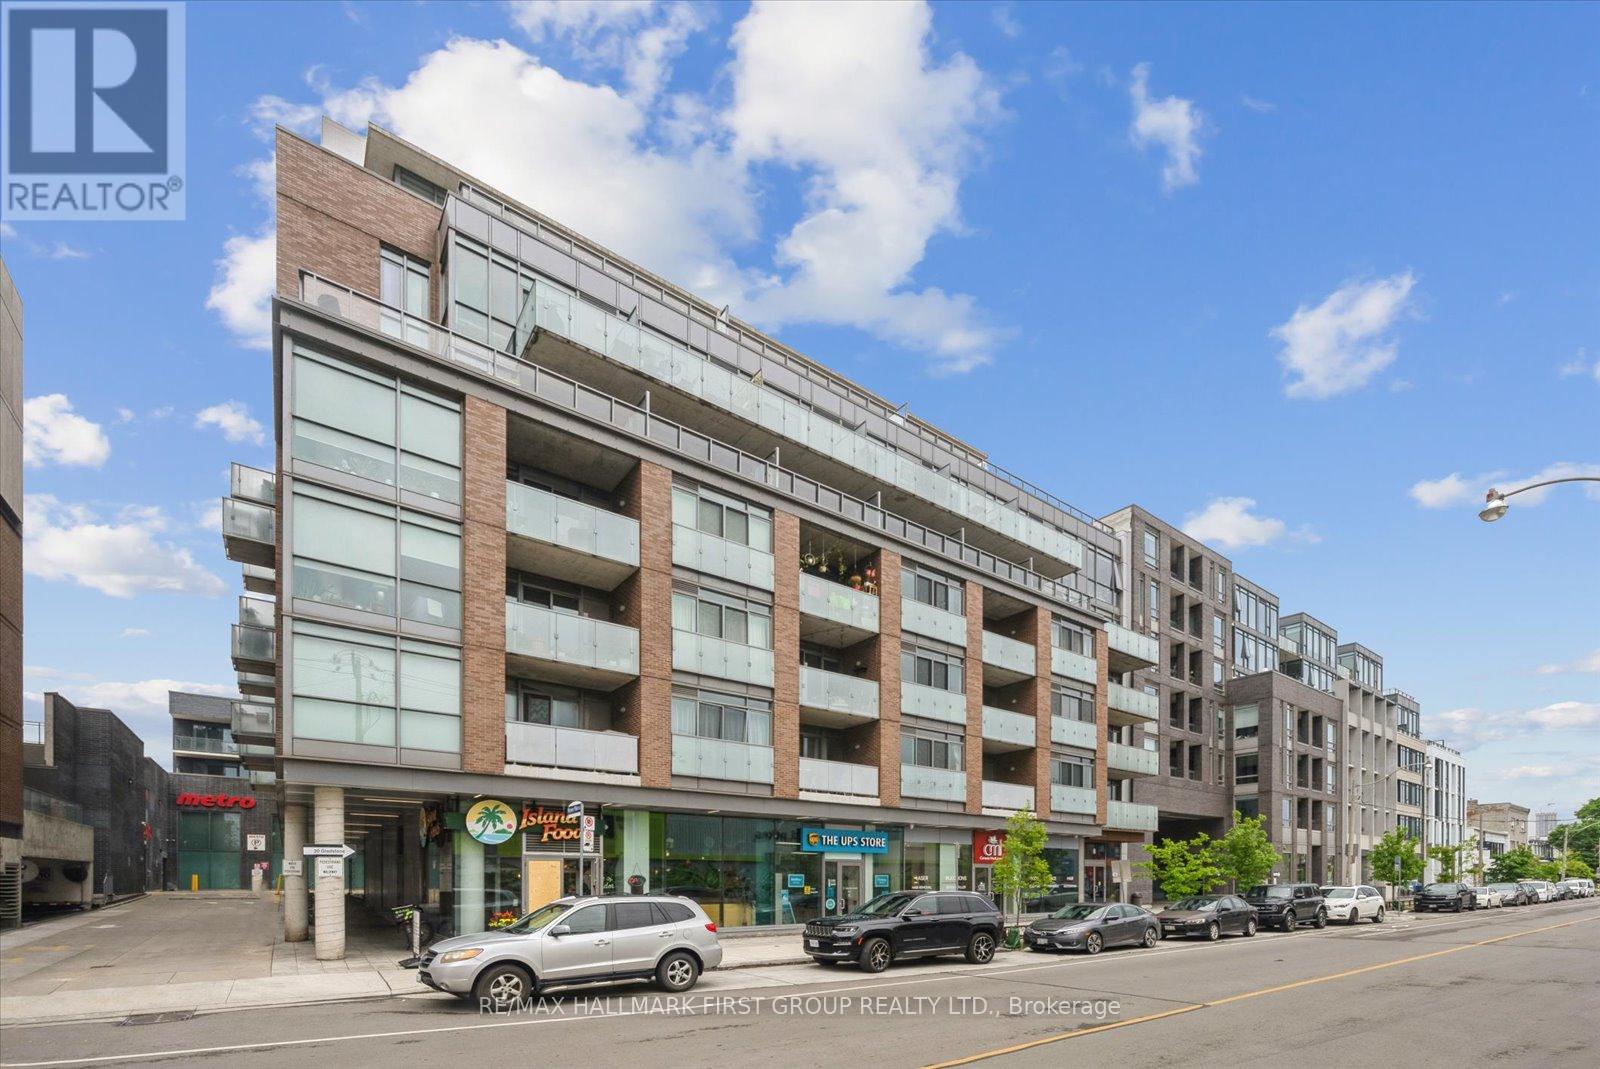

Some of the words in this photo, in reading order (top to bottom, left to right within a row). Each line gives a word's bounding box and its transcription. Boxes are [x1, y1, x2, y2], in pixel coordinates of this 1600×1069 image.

[176, 793, 256, 809] metro
[821, 835, 838, 846] THE
[840, 836, 858, 846] UPS
[860, 837, 886, 848] STORE
